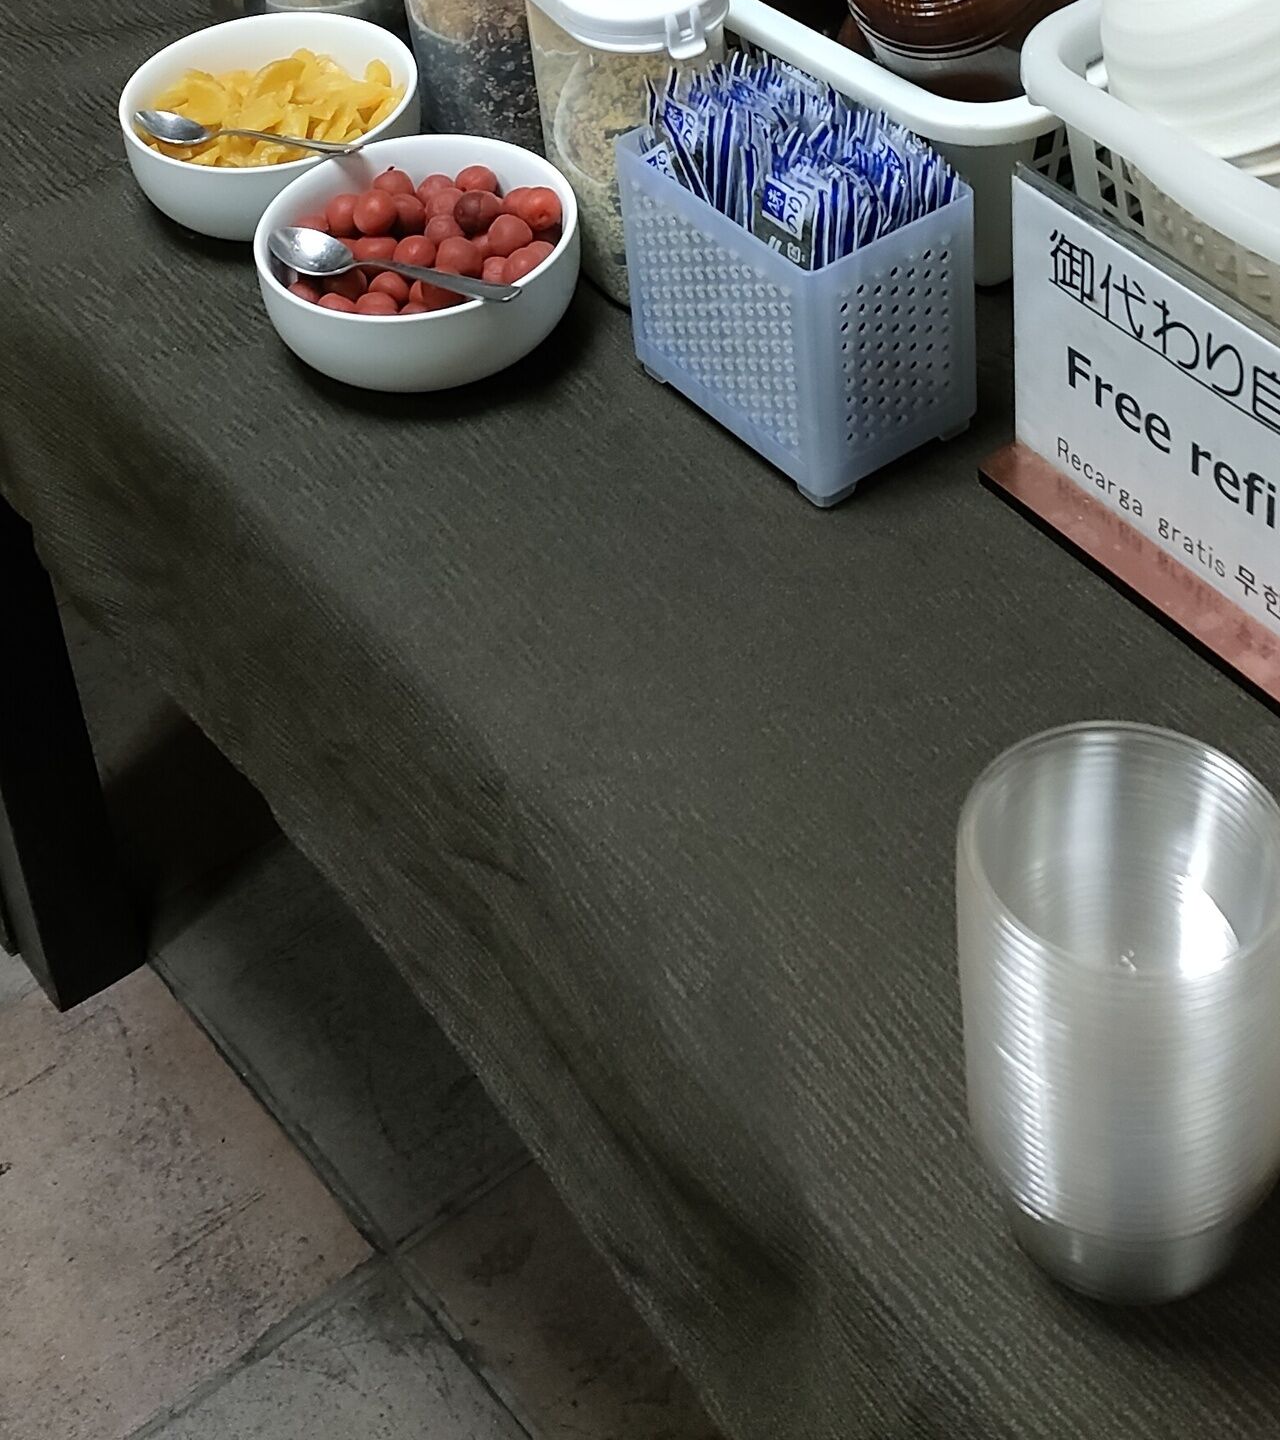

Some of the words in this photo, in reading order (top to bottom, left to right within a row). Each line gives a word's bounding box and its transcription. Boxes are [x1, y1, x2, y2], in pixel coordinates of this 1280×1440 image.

[1067, 345, 1171, 455] Free
[1057, 436, 1144, 517] Recarga
[1157, 516, 1226, 579] gratis
